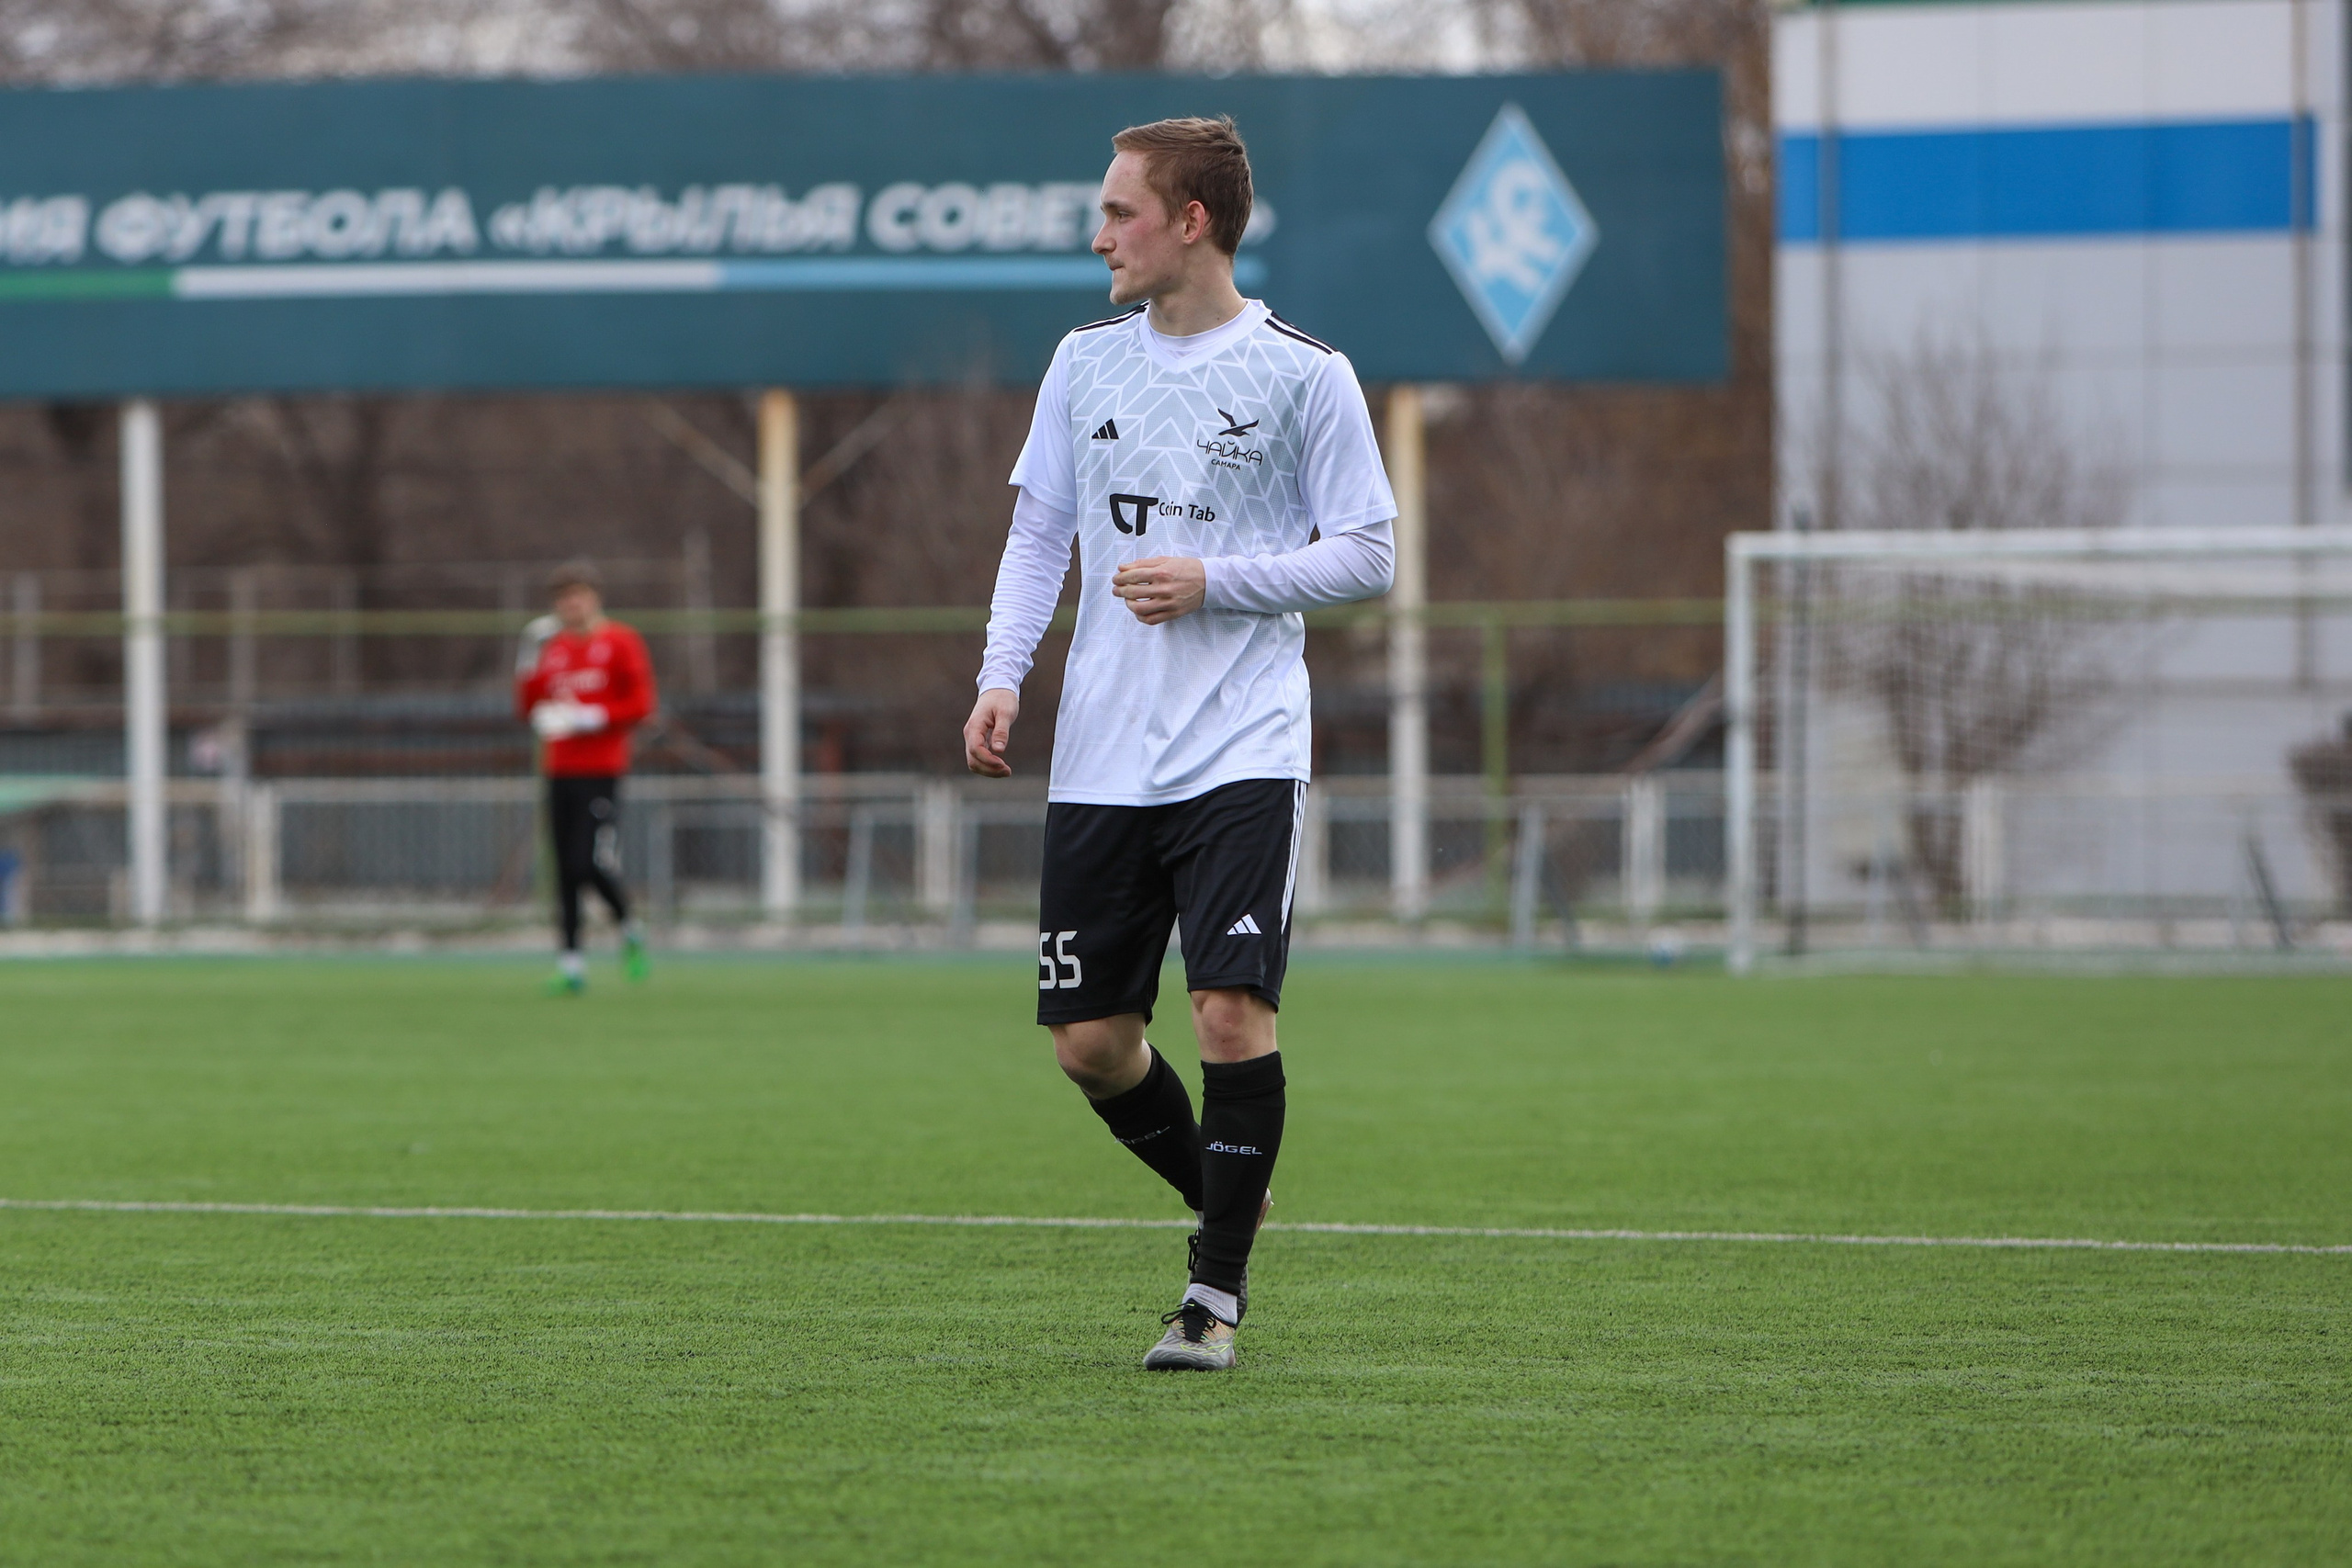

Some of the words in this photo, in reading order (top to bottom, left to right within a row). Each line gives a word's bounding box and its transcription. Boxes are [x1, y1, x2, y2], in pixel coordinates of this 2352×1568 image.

[96, 186, 480, 260] ФУТБОЛА
[1196, 439, 1263, 466] ЧАЙКА
[1211, 458, 1240, 470] САМАРА
[1188, 503, 1216, 522] Tab
[1039, 931, 1082, 989] 55
[1205, 1141, 1262, 1155] JÖGEL
